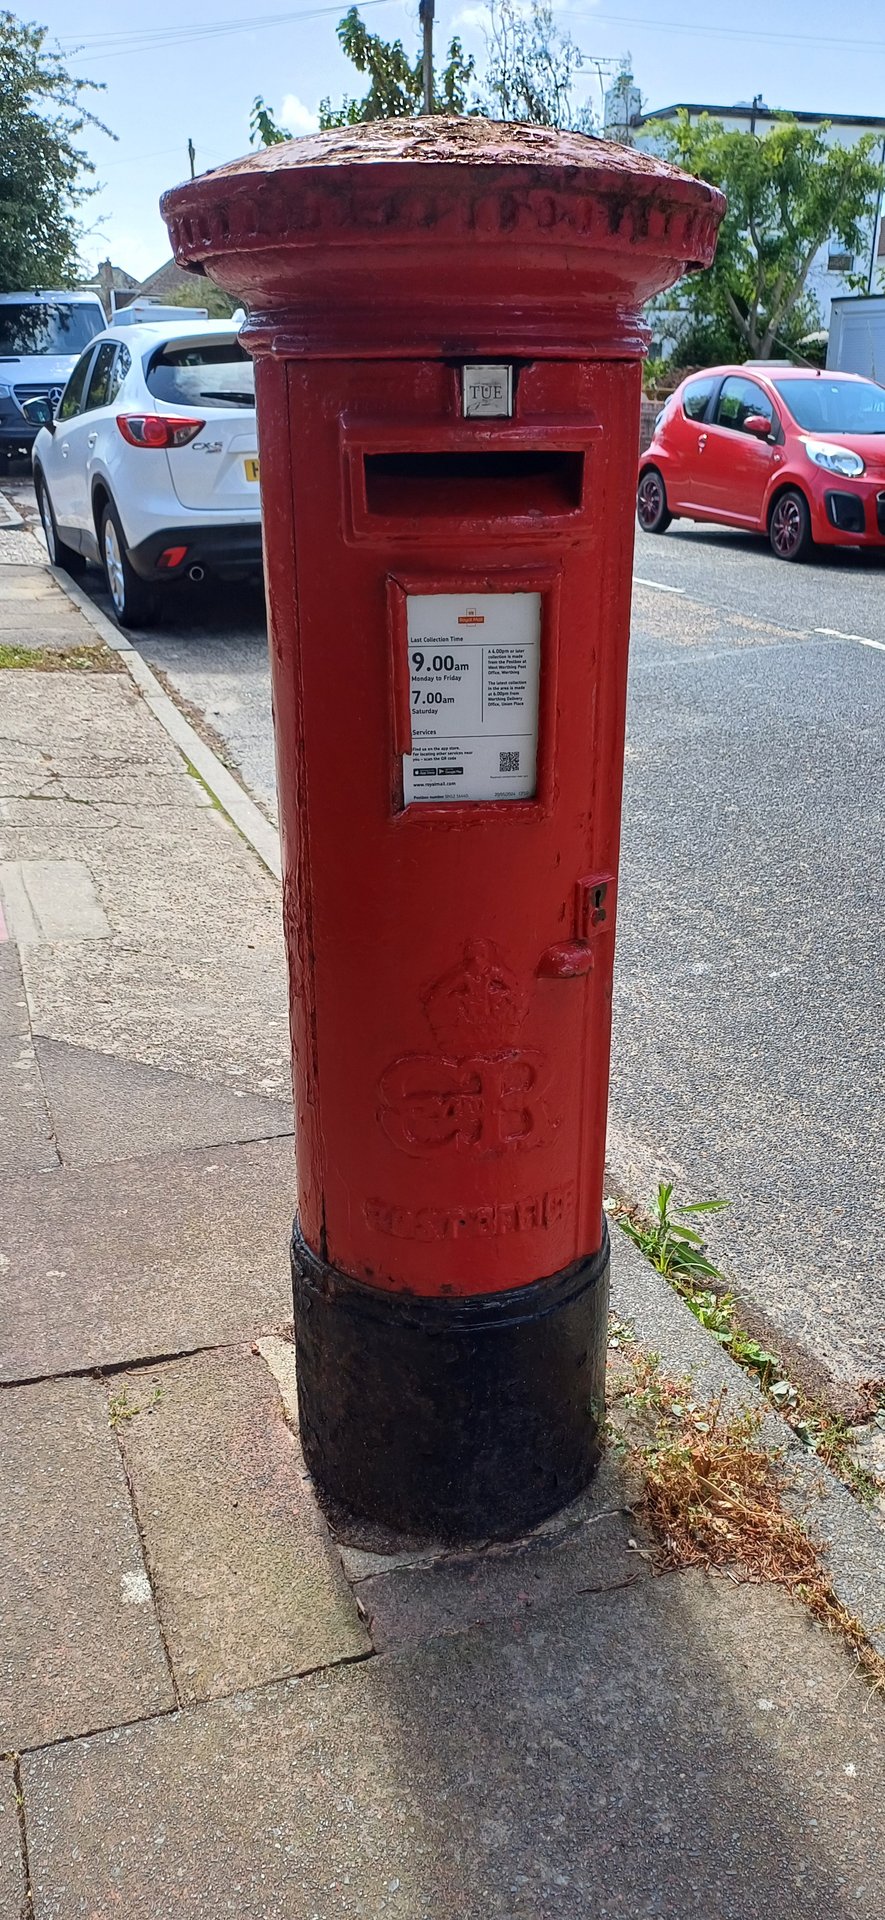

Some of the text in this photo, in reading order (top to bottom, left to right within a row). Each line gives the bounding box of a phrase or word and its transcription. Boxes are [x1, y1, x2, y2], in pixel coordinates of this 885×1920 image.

[469, 385, 503, 400] TUE
[412, 652, 469, 672] 9.00am
[412, 691, 454, 704] 7.00am
